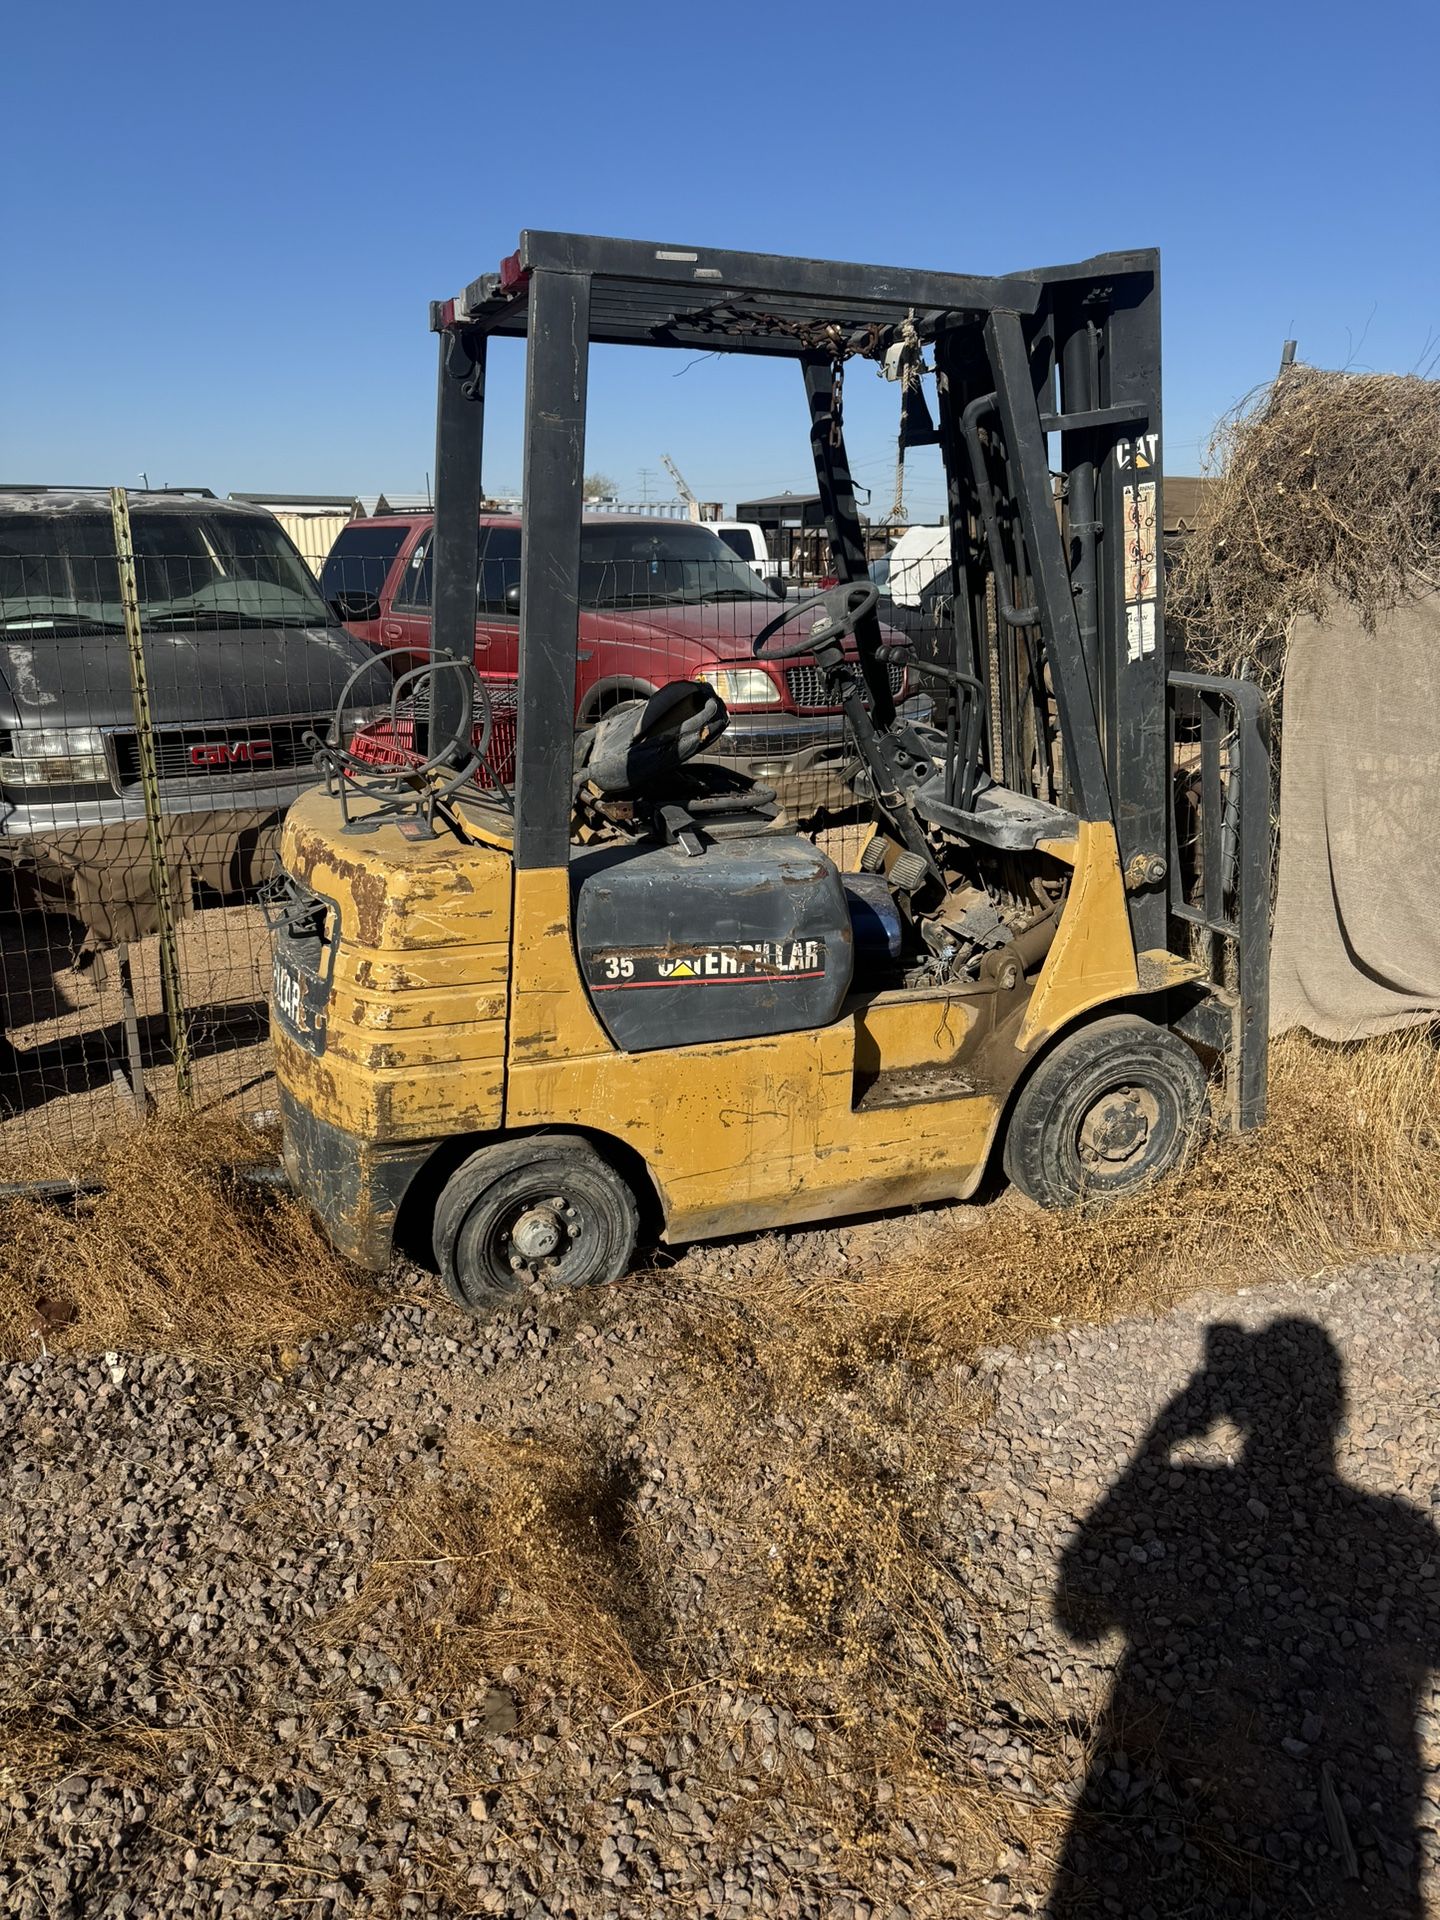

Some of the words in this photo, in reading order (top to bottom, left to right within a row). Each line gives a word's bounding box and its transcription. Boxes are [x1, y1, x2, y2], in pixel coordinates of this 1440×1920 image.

[1116, 432, 1159, 470] CAT
[189, 739, 273, 765] GMC
[605, 957, 635, 979] 35
